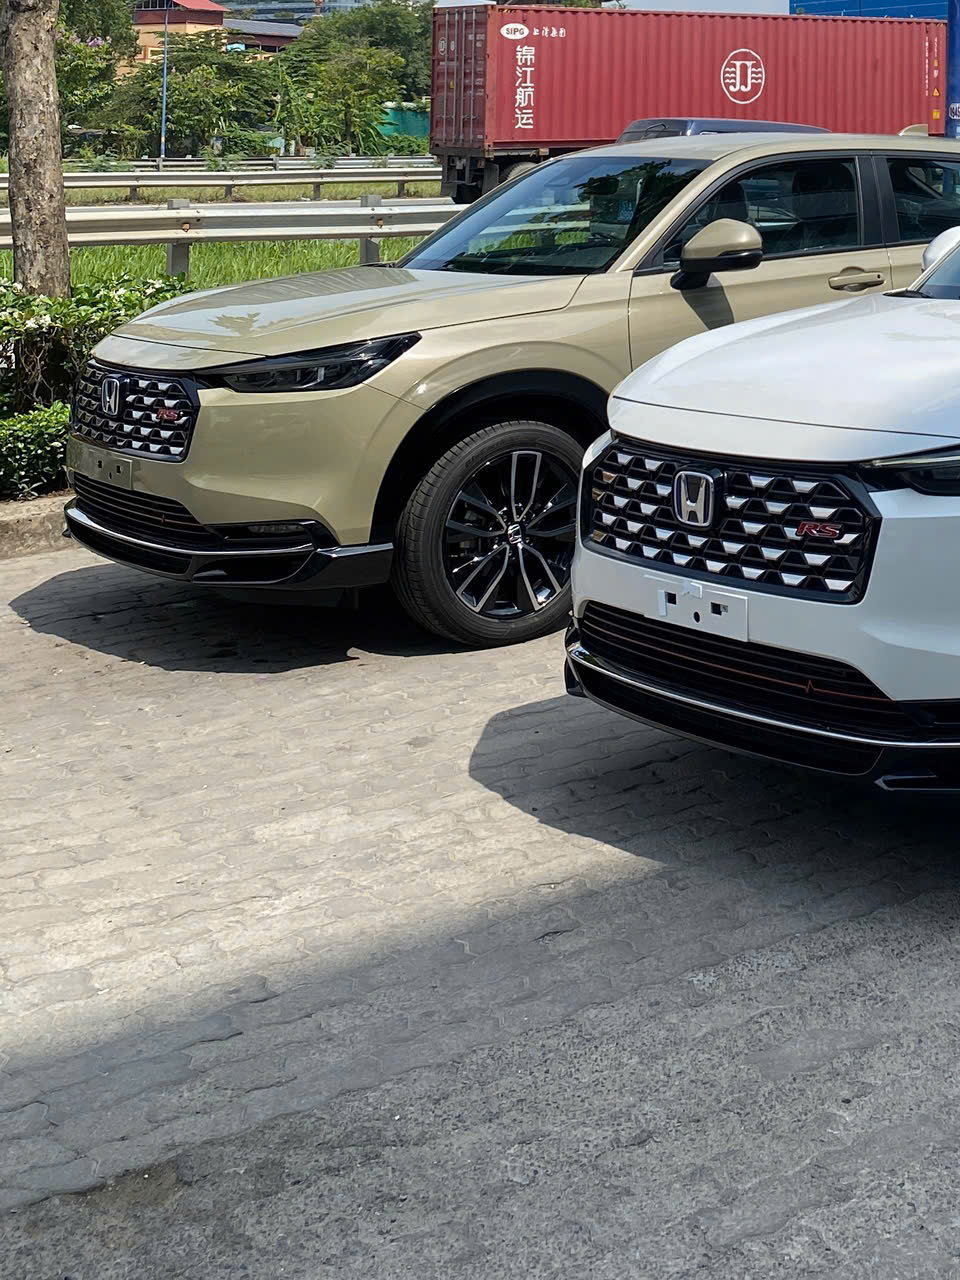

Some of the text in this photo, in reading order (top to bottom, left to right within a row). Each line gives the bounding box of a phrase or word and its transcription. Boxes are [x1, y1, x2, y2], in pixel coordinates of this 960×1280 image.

[505, 27, 525, 36] SIPG
[514, 44, 536, 129] 锦江航运
[157, 408, 179, 420] RS
[796, 521, 842, 538] RS
